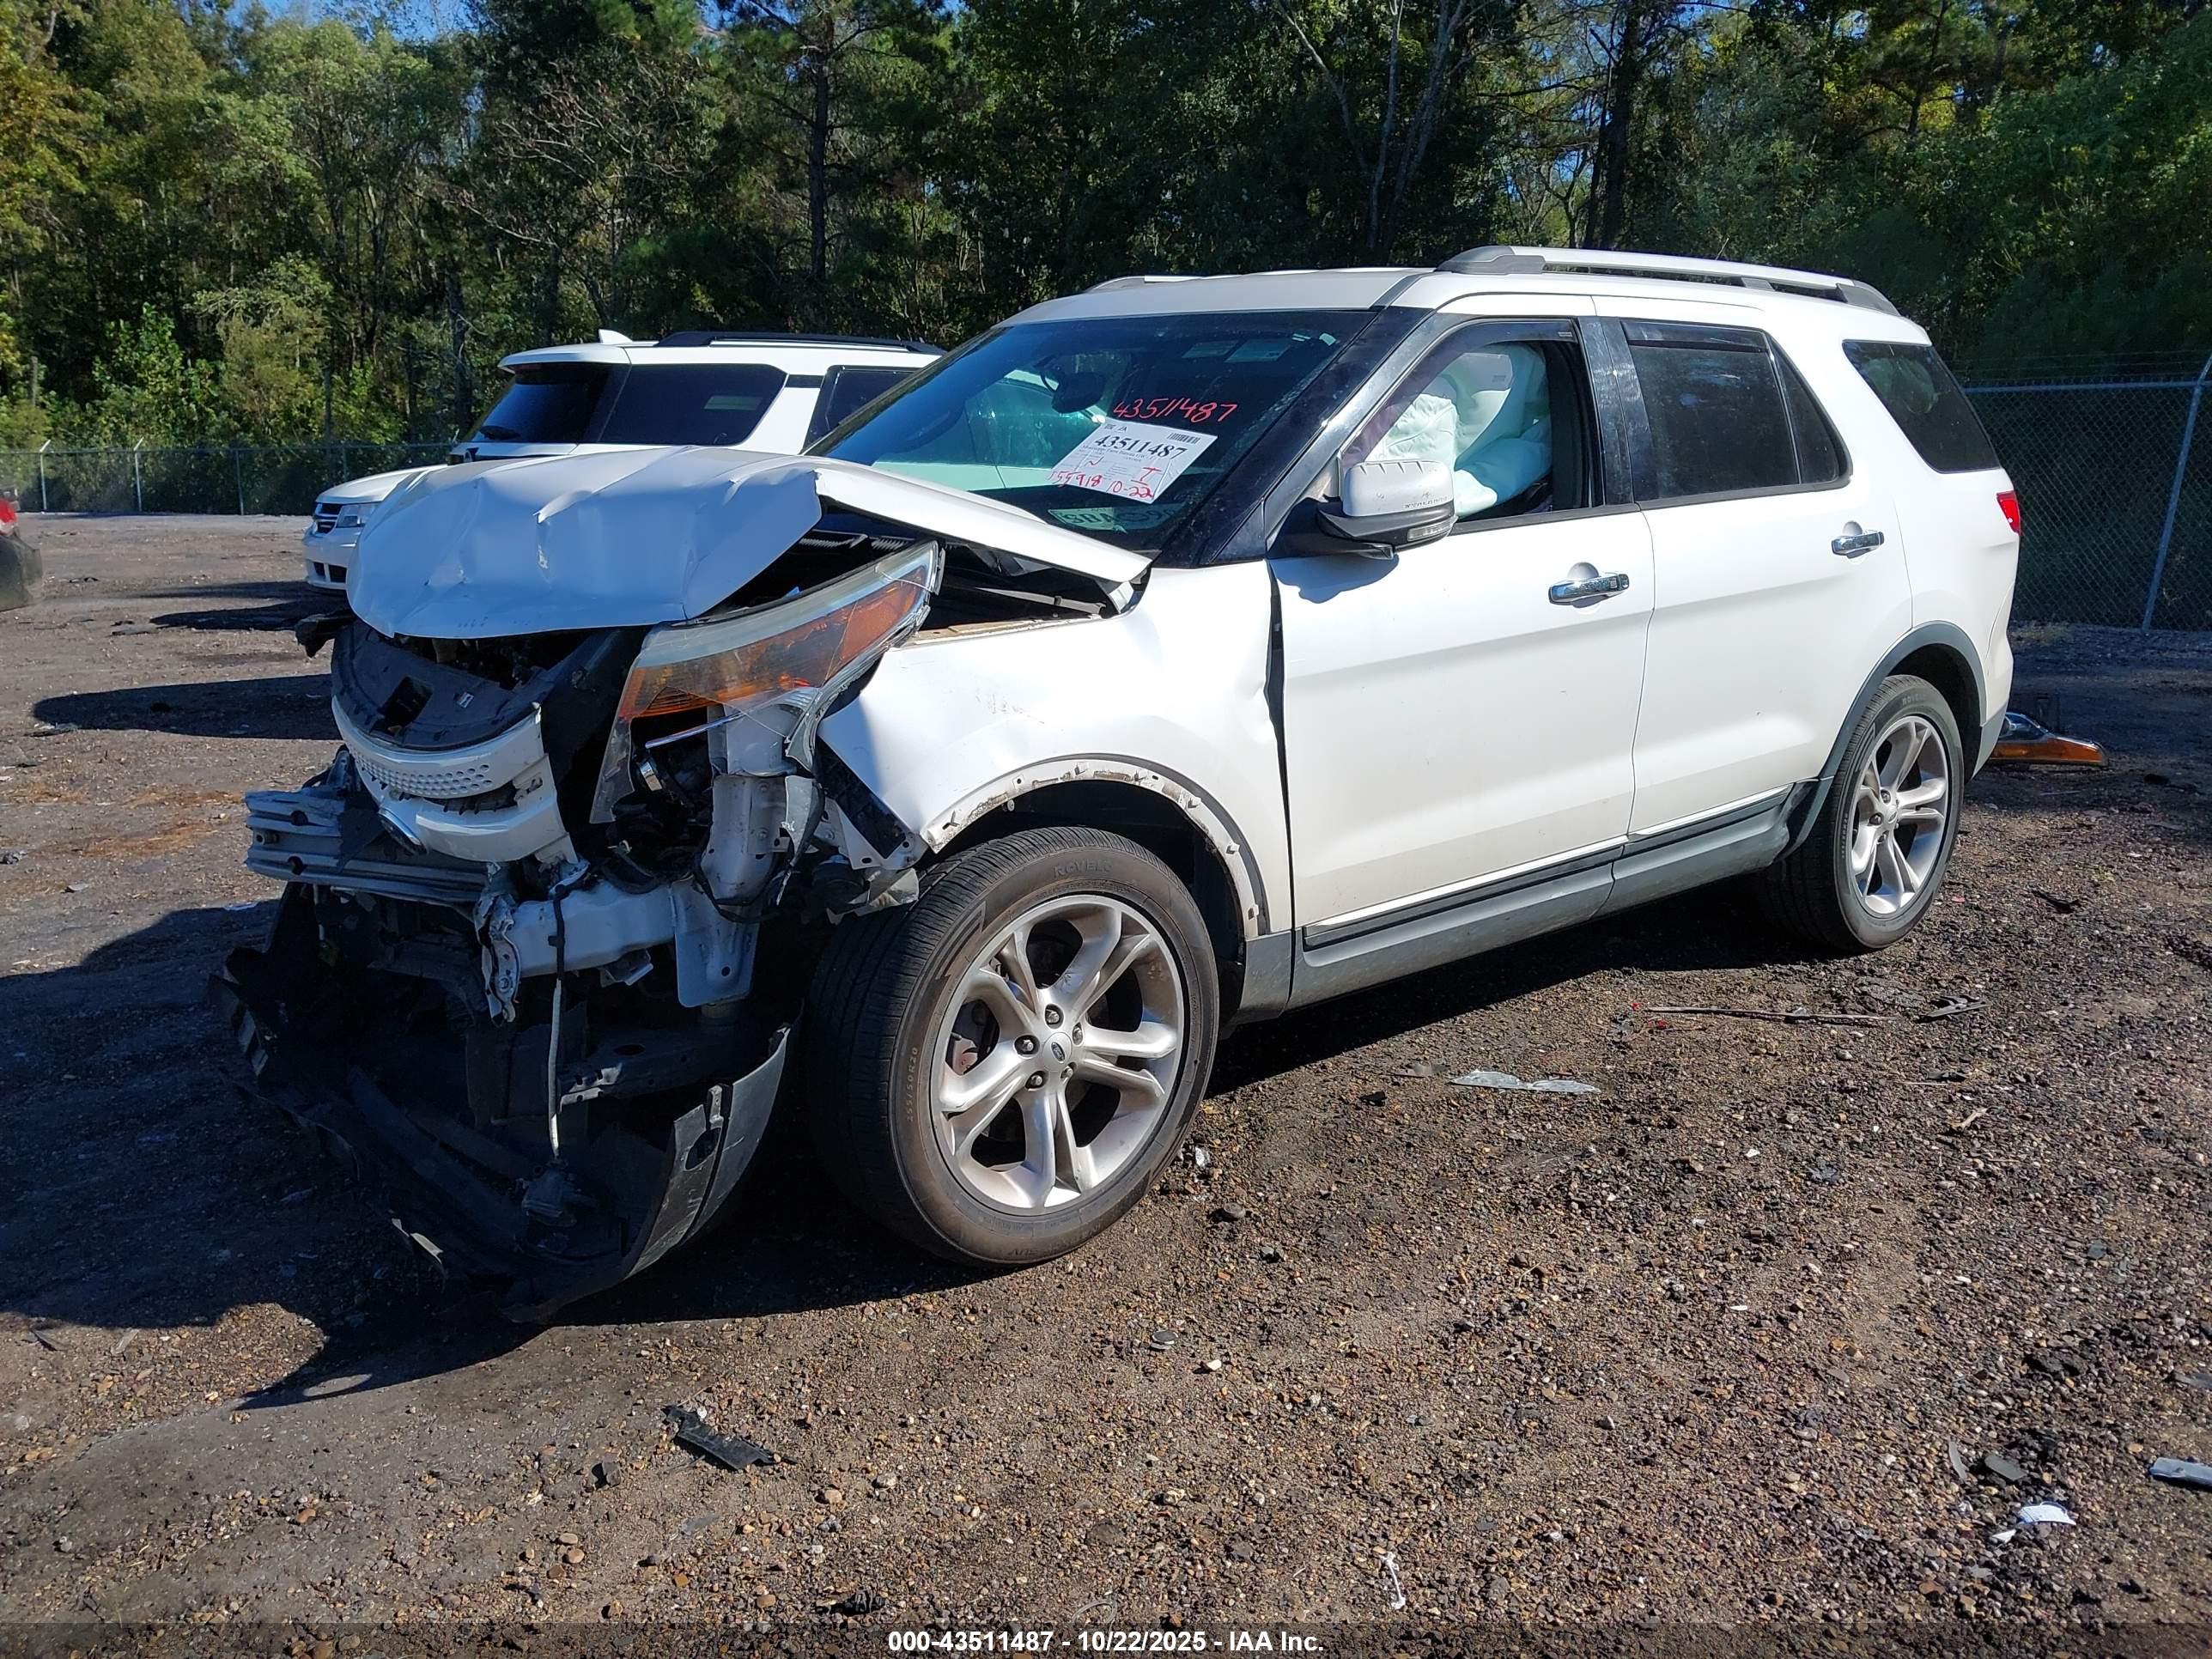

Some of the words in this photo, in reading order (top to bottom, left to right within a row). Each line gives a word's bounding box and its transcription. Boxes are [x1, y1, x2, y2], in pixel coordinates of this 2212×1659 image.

[1113, 398, 1237, 423] 43511487
[1095, 434, 1189, 460] 43511487
[1105, 478, 1154, 500] 10-22
